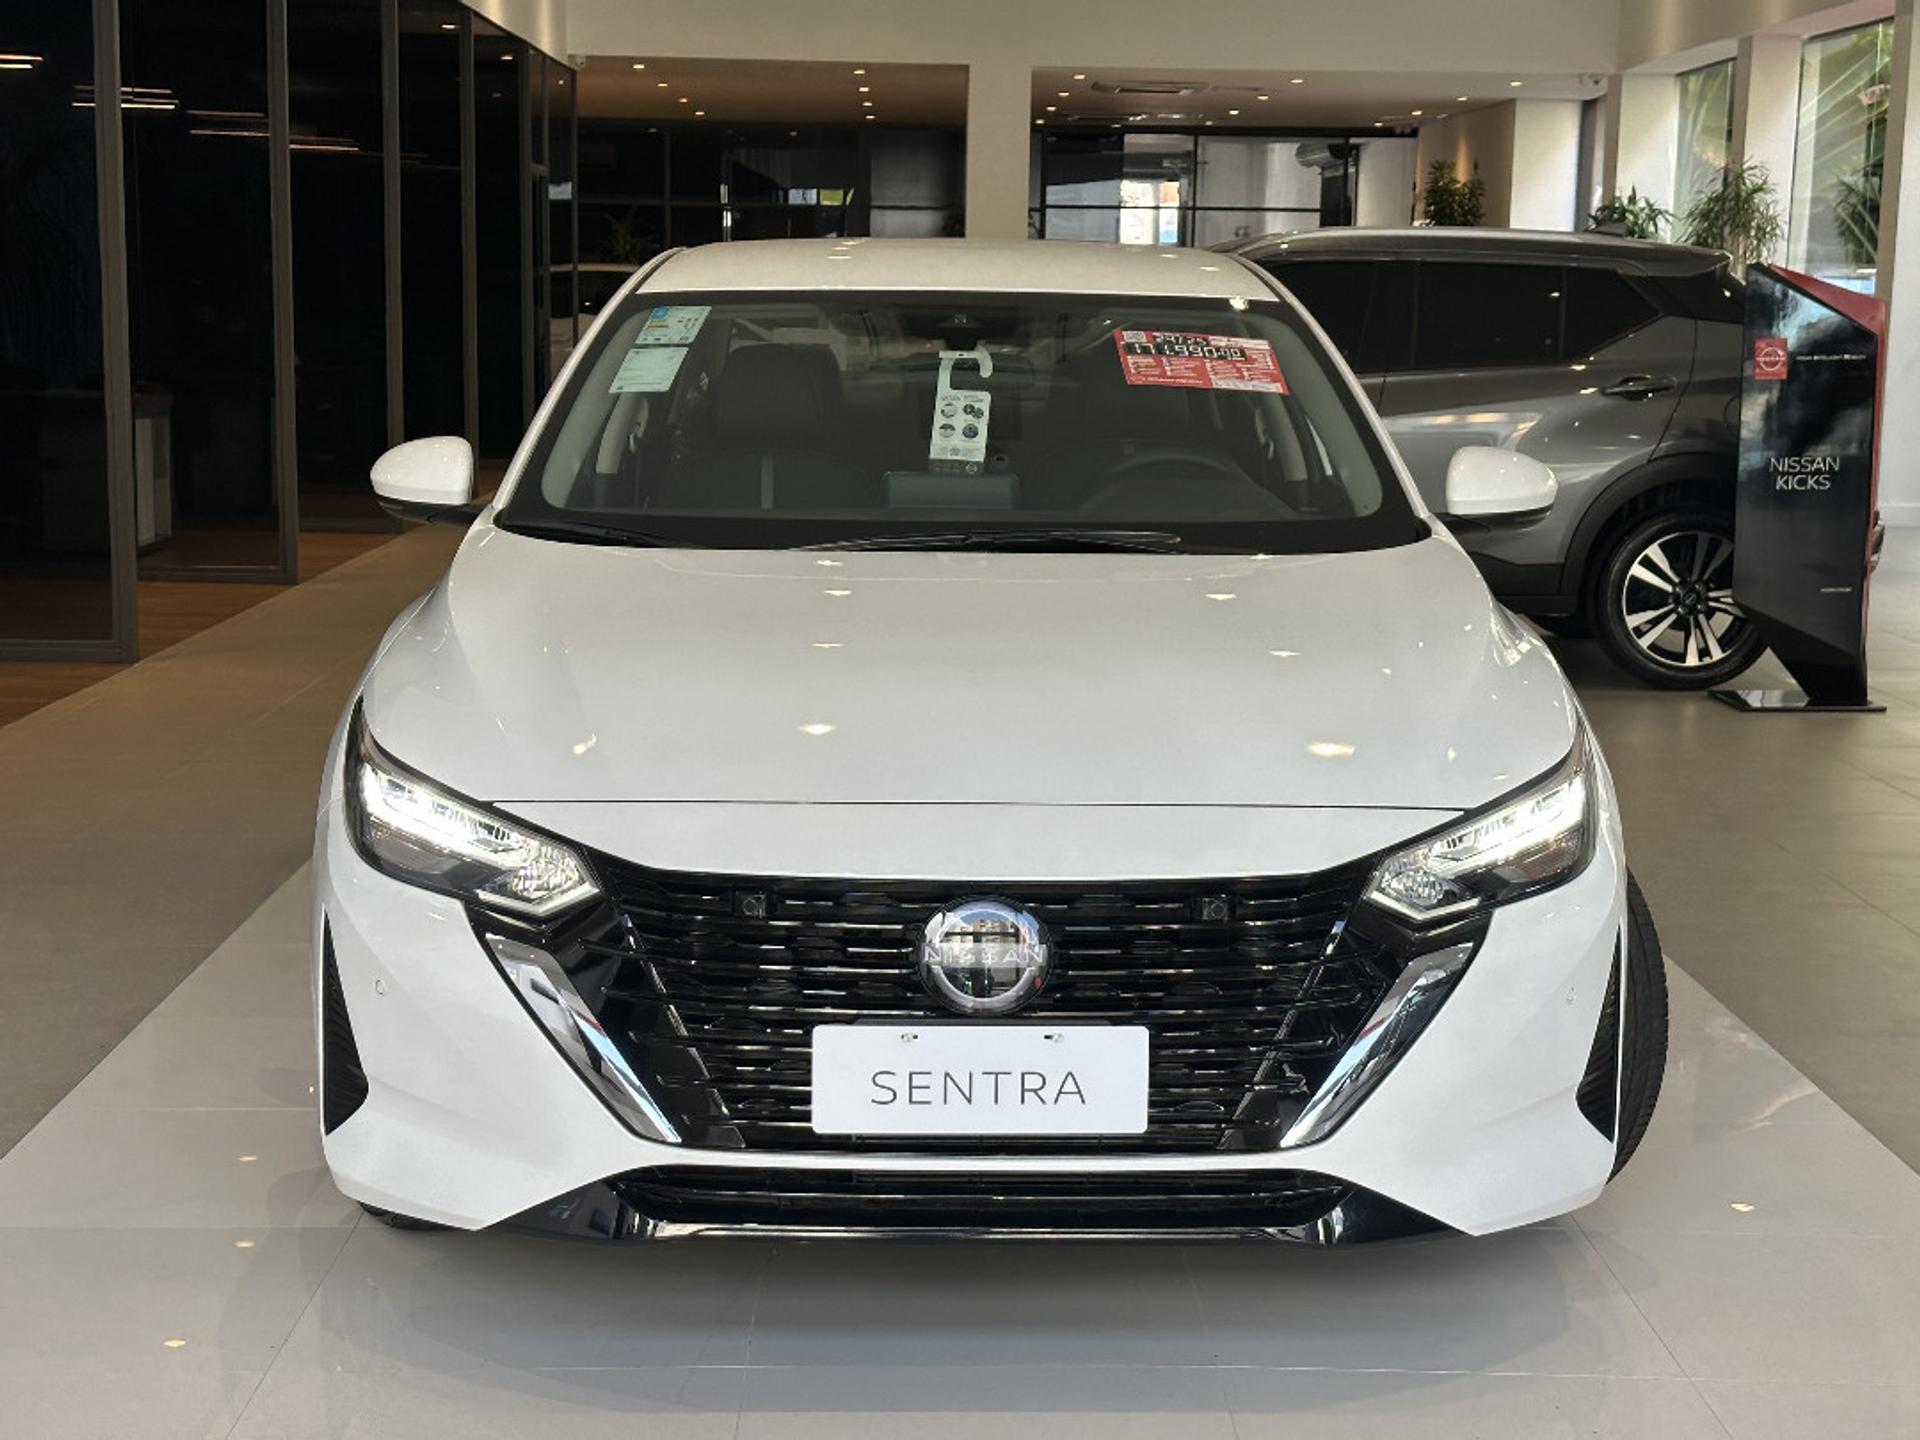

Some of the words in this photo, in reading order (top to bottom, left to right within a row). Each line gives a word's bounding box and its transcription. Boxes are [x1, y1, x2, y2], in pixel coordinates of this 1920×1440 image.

[1769, 456, 1840, 473] NISSAN
[1775, 474, 1831, 491] KICKS
[923, 944, 1044, 963] NISSAN
[871, 1070, 1086, 1106] SENTRA
